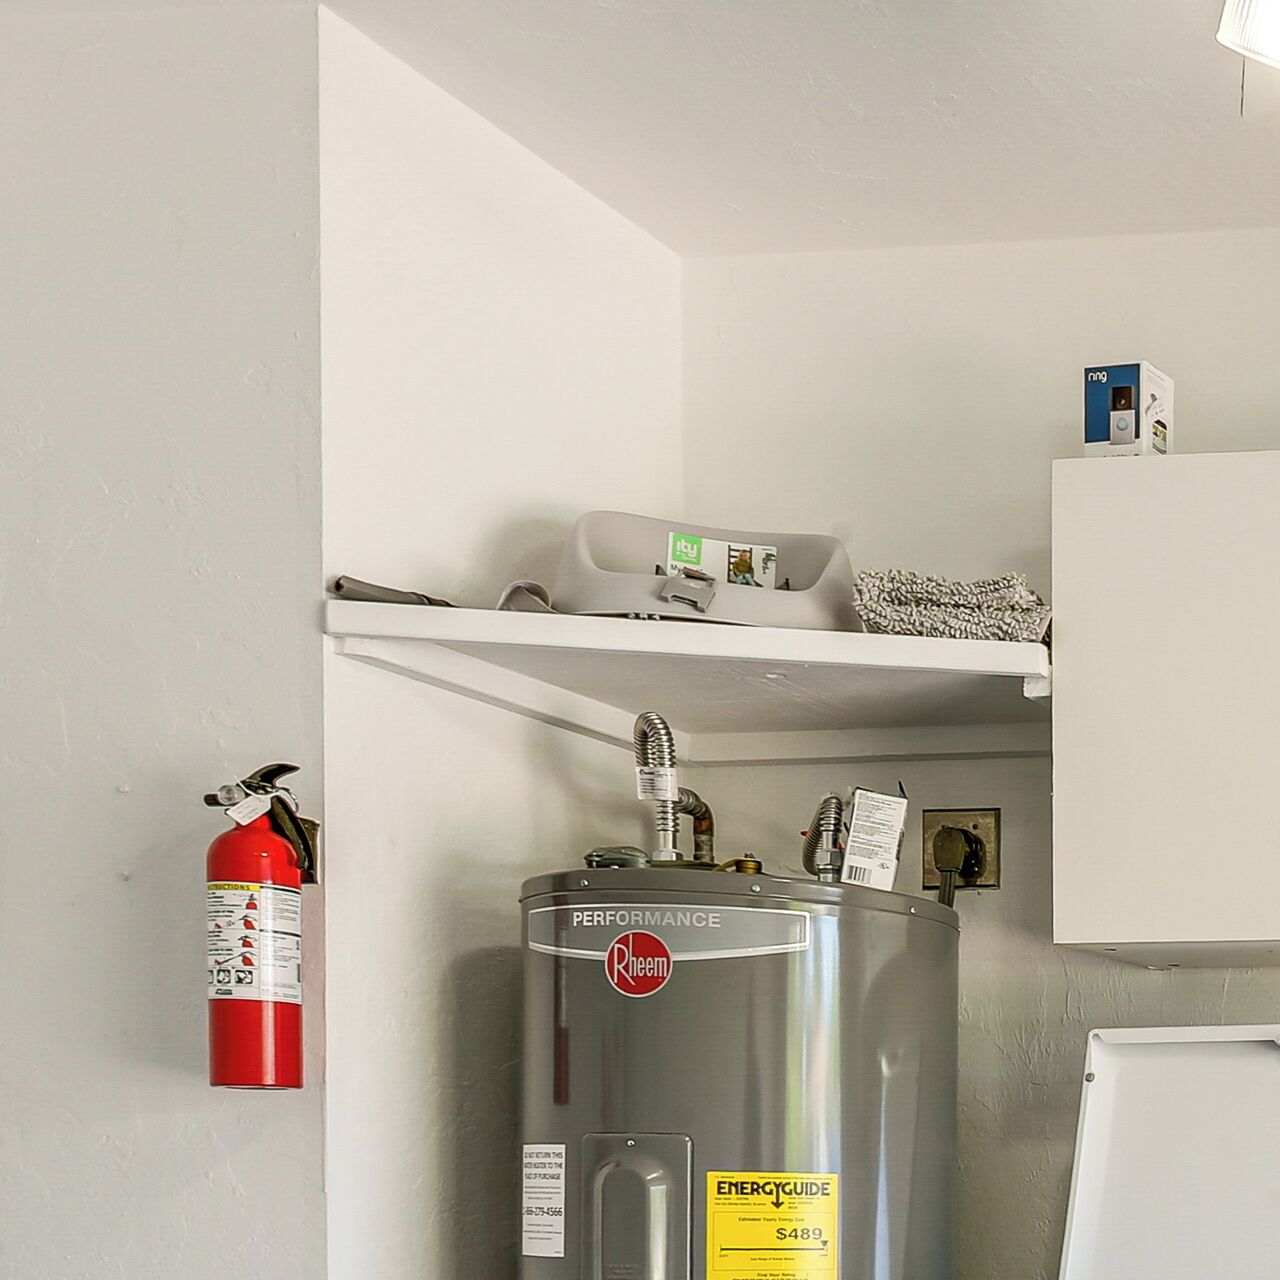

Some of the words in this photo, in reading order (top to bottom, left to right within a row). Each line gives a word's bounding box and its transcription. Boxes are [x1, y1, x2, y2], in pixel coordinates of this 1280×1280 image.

[1088, 371, 1107, 383] ring
[676, 538, 697, 559] ity
[573, 910, 721, 928] PERFORMANCE
[613, 933, 668, 986] Rheem
[717, 1180, 831, 1197] ENERGYGUIDE
[775, 1227, 822, 1241] $489
